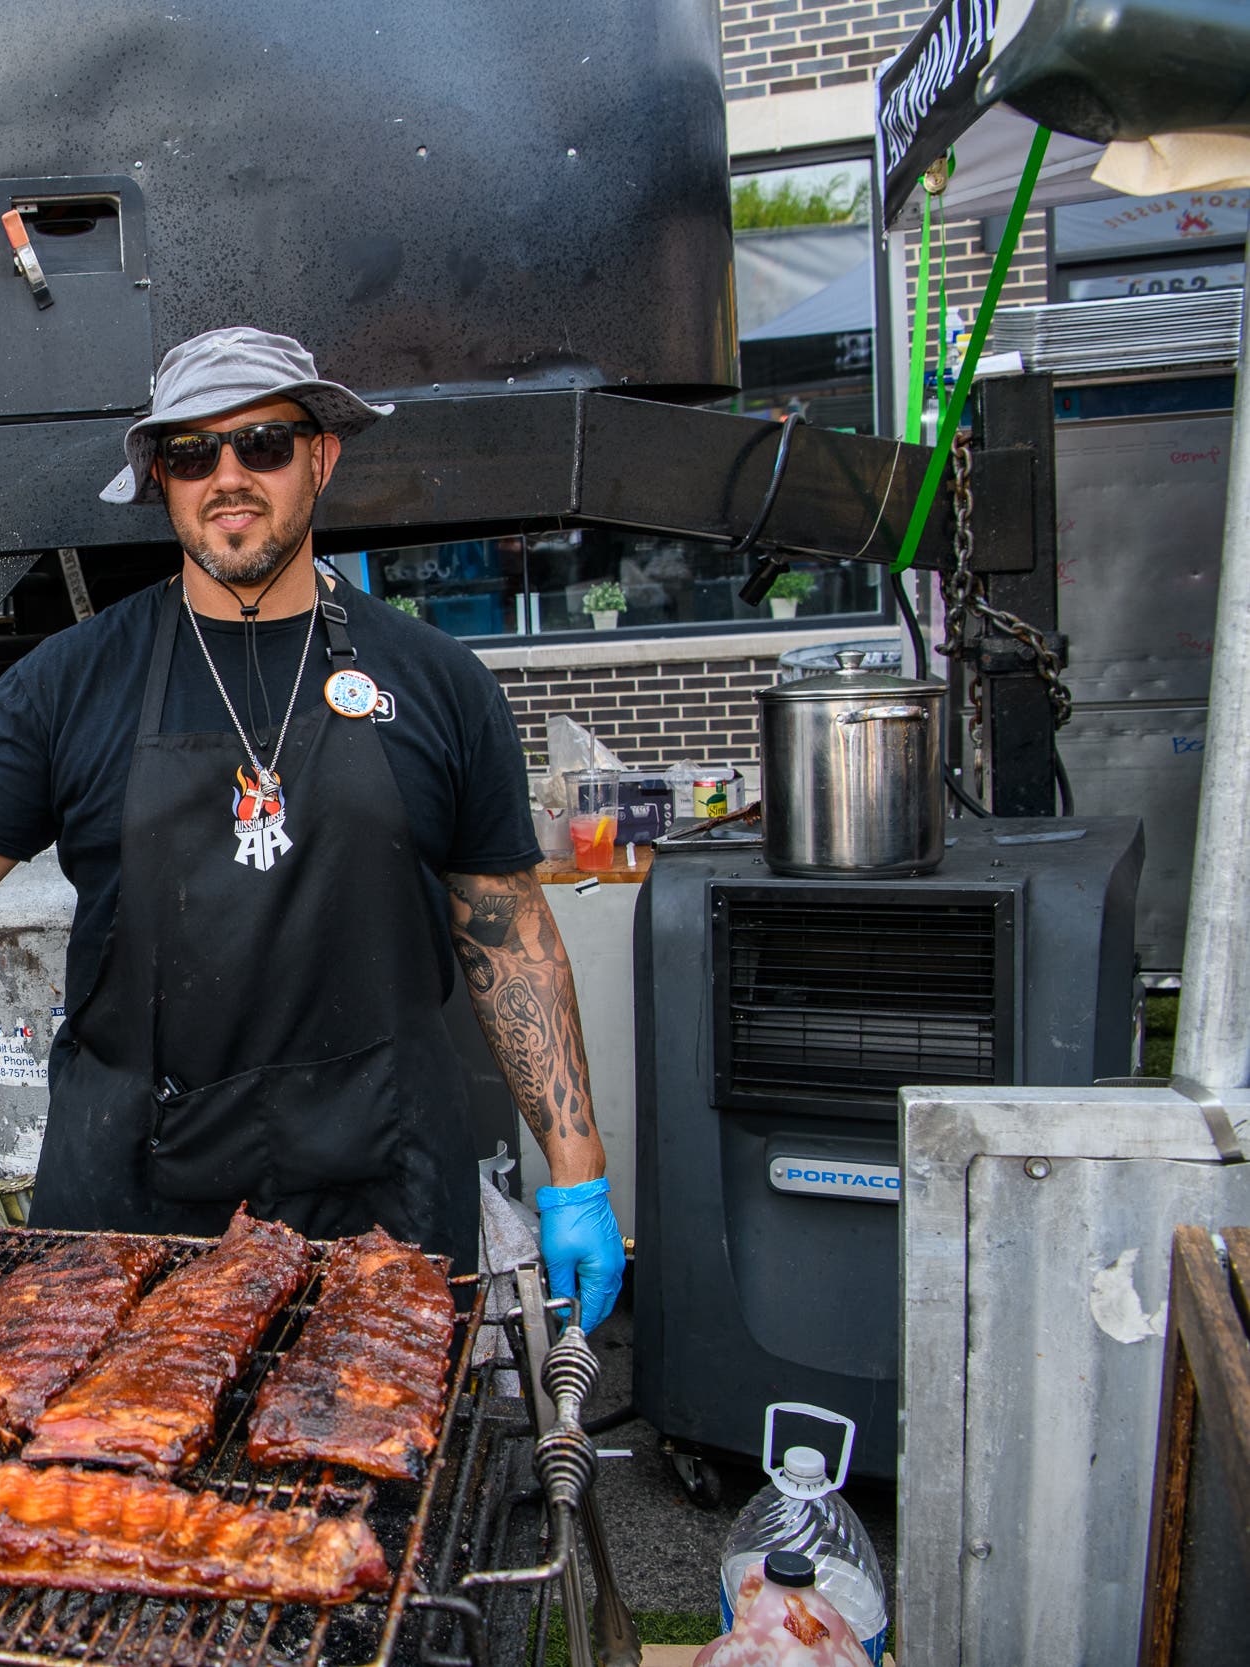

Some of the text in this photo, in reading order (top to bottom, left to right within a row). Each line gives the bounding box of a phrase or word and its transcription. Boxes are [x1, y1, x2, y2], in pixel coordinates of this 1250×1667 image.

[234, 807, 286, 833] AUSSOM AUSSIE
[56, 1008, 66, 1016] BY
[3, 1055, 34, 1066] Phone
